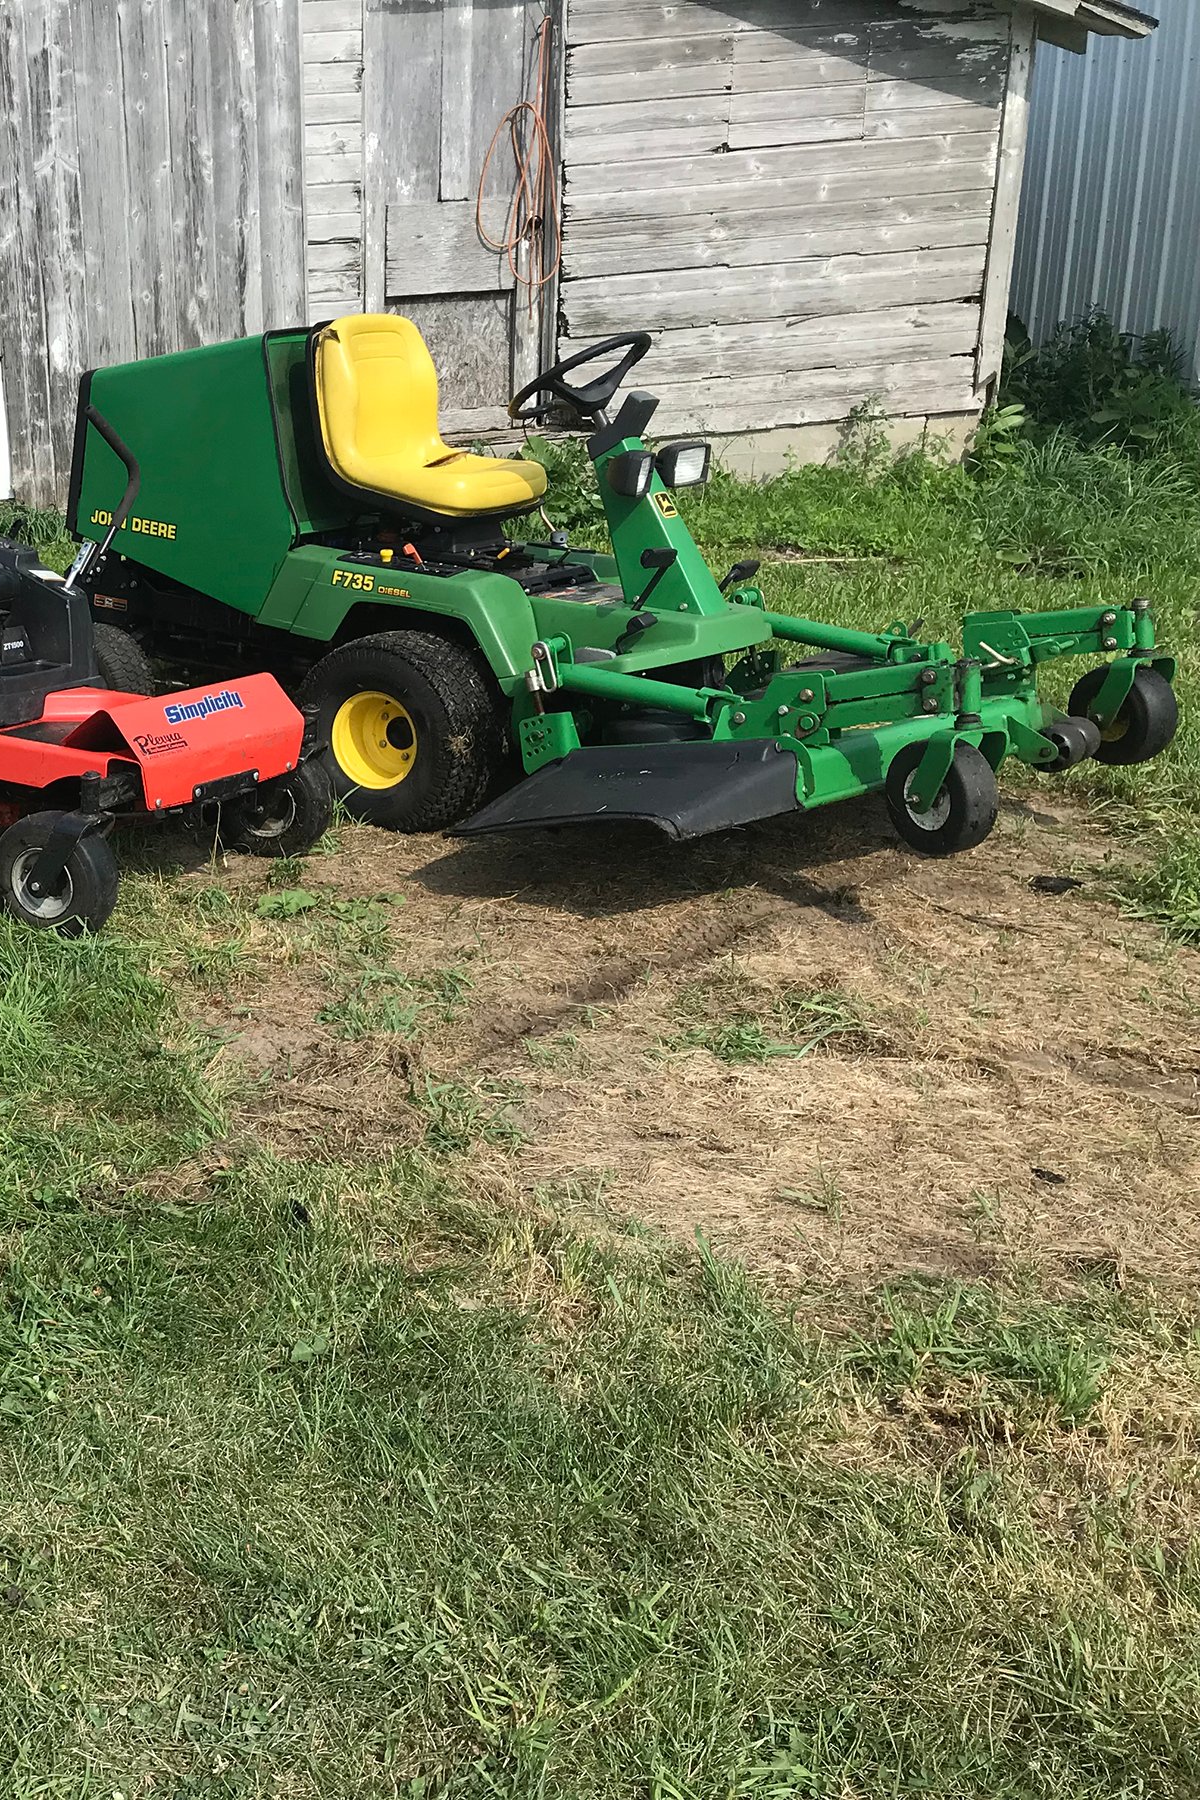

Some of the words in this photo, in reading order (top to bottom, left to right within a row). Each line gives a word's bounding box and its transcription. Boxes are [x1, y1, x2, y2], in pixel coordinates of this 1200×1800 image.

[131, 516, 177, 540] DEERE
[331, 569, 375, 592] F735
[377, 585, 411, 598] DIESEL
[164, 690, 244, 724] Simplicity
